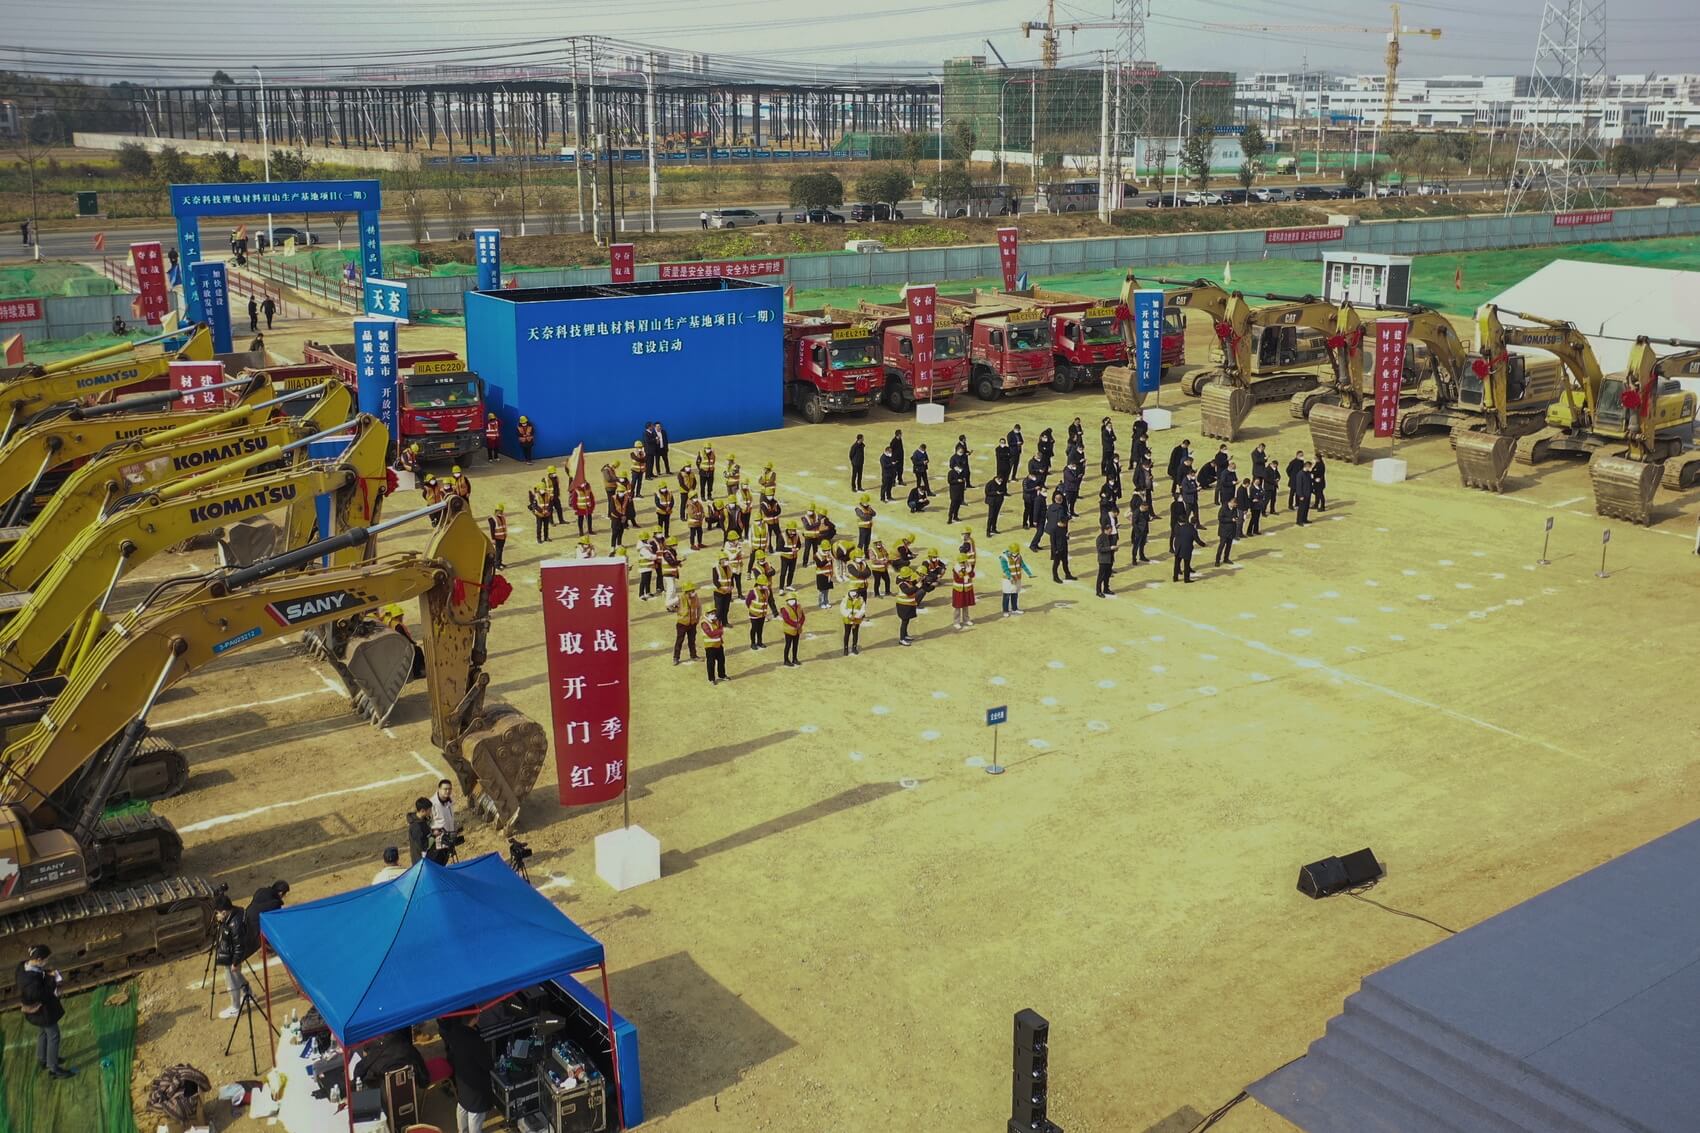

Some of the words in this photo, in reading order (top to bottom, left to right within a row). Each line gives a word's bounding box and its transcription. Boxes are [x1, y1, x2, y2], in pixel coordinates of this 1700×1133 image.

[373, 288, 401, 313] 天奈
[1176, 296, 1187, 305] CAT
[528, 310, 775, 341] 天奈科技锂电材料眉山生产基地项目(一期)
[1284, 313, 1297, 323] CAT
[362, 330, 375, 377] 品质立市
[378, 330, 392, 377] 制造强市
[631, 339, 683, 355] 建设启动
[1523, 335, 1557, 344] KOMATSU
[76, 369, 138, 389] KOMATSU
[200, 375, 216, 404] 建设
[173, 435, 269, 472] KOMATSU
[189, 484, 296, 524] KOMATSU
[286, 593, 346, 620] SANY
[555, 585, 595, 788] 夺取开门红
[590, 584, 624, 785] 奋战一季度
[40, 862, 65, 874] SANY
